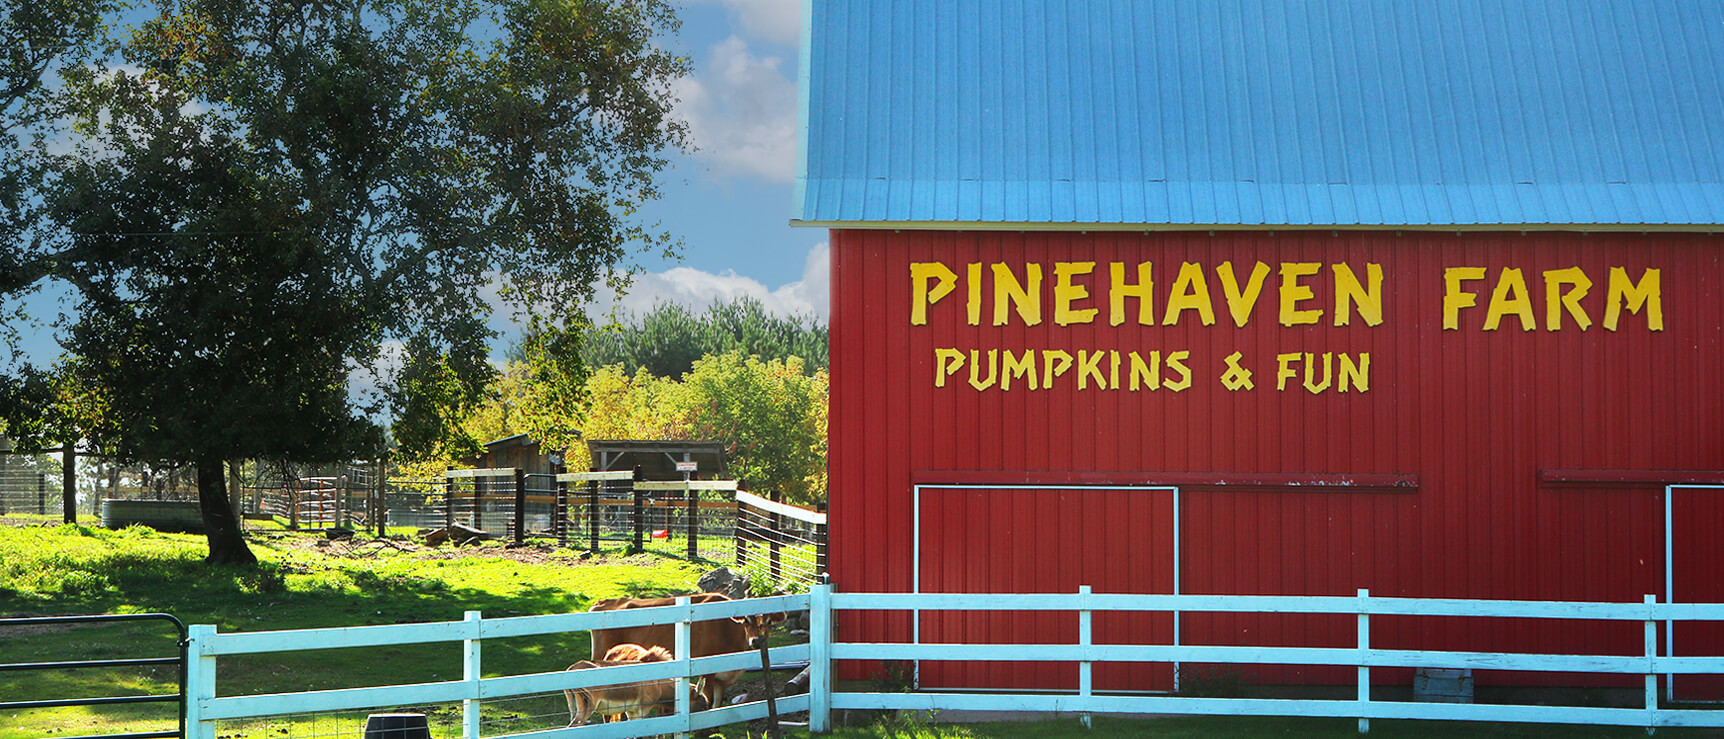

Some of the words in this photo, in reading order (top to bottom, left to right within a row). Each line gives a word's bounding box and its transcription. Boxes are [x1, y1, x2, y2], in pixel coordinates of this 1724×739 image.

[909, 261, 1384, 328] PINEHAVEN
[1442, 266, 1664, 332] FARM
[935, 347, 1192, 392] PUMPKINS
[1220, 351, 1255, 391] &
[1276, 352, 1371, 393] FUN
